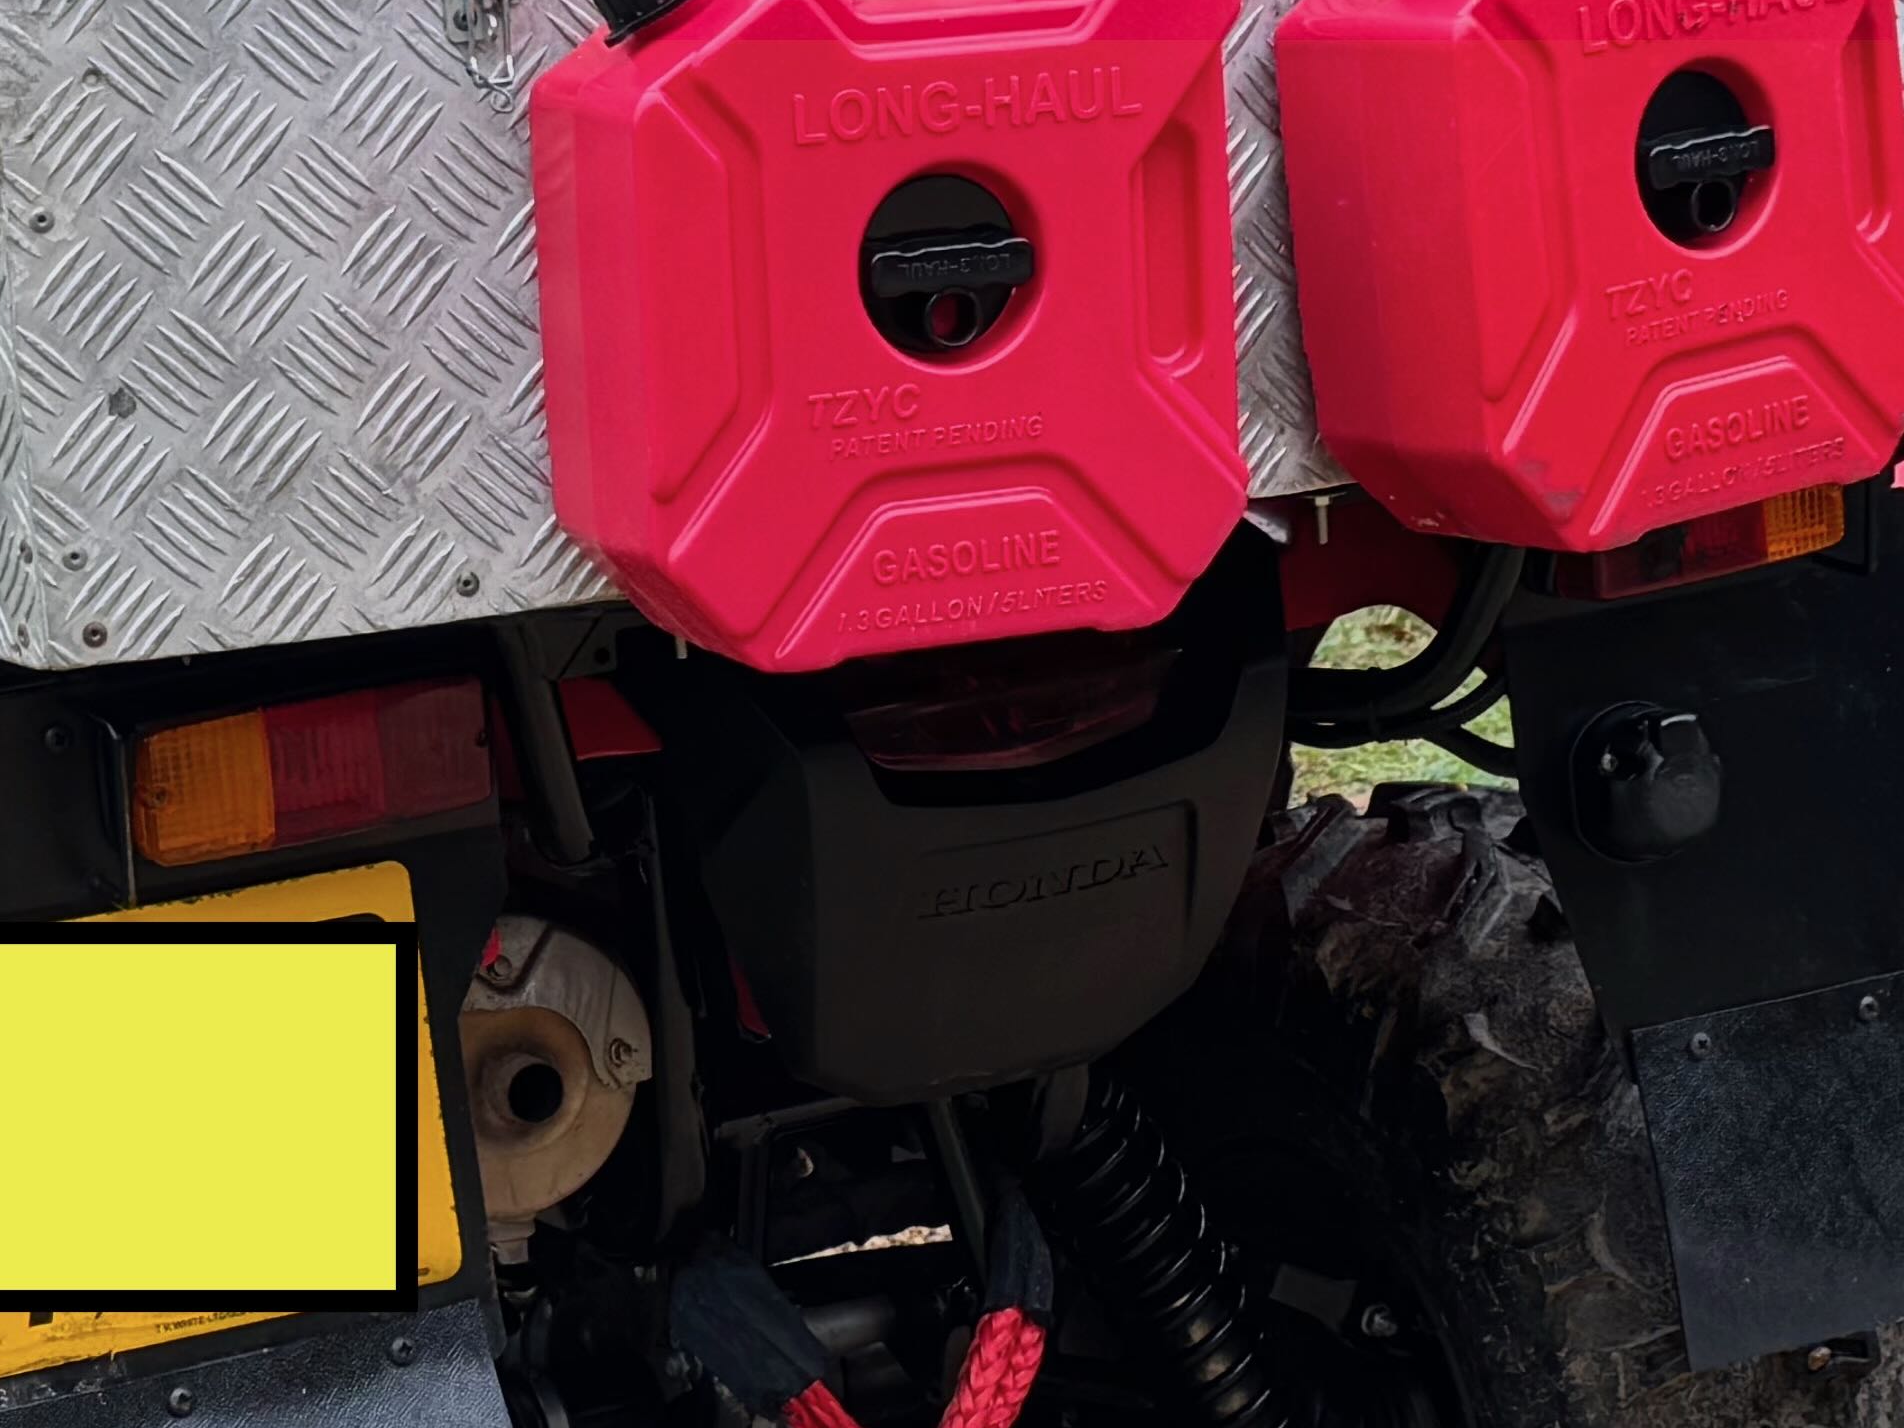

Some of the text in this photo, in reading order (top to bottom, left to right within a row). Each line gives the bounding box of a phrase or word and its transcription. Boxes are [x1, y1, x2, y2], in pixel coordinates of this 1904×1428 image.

[792, 65, 1143, 146] LONG-HAUL
[1604, 268, 1694, 320] TZYC
[1626, 288, 1789, 347] PATENT PENDING
[807, 383, 921, 430] TZYC
[1664, 395, 1810, 460] GASOLINE
[830, 414, 1043, 461] PATENT PENDING
[872, 529, 1061, 586] GASOLINE
[916, 845, 1170, 920] HONDA
